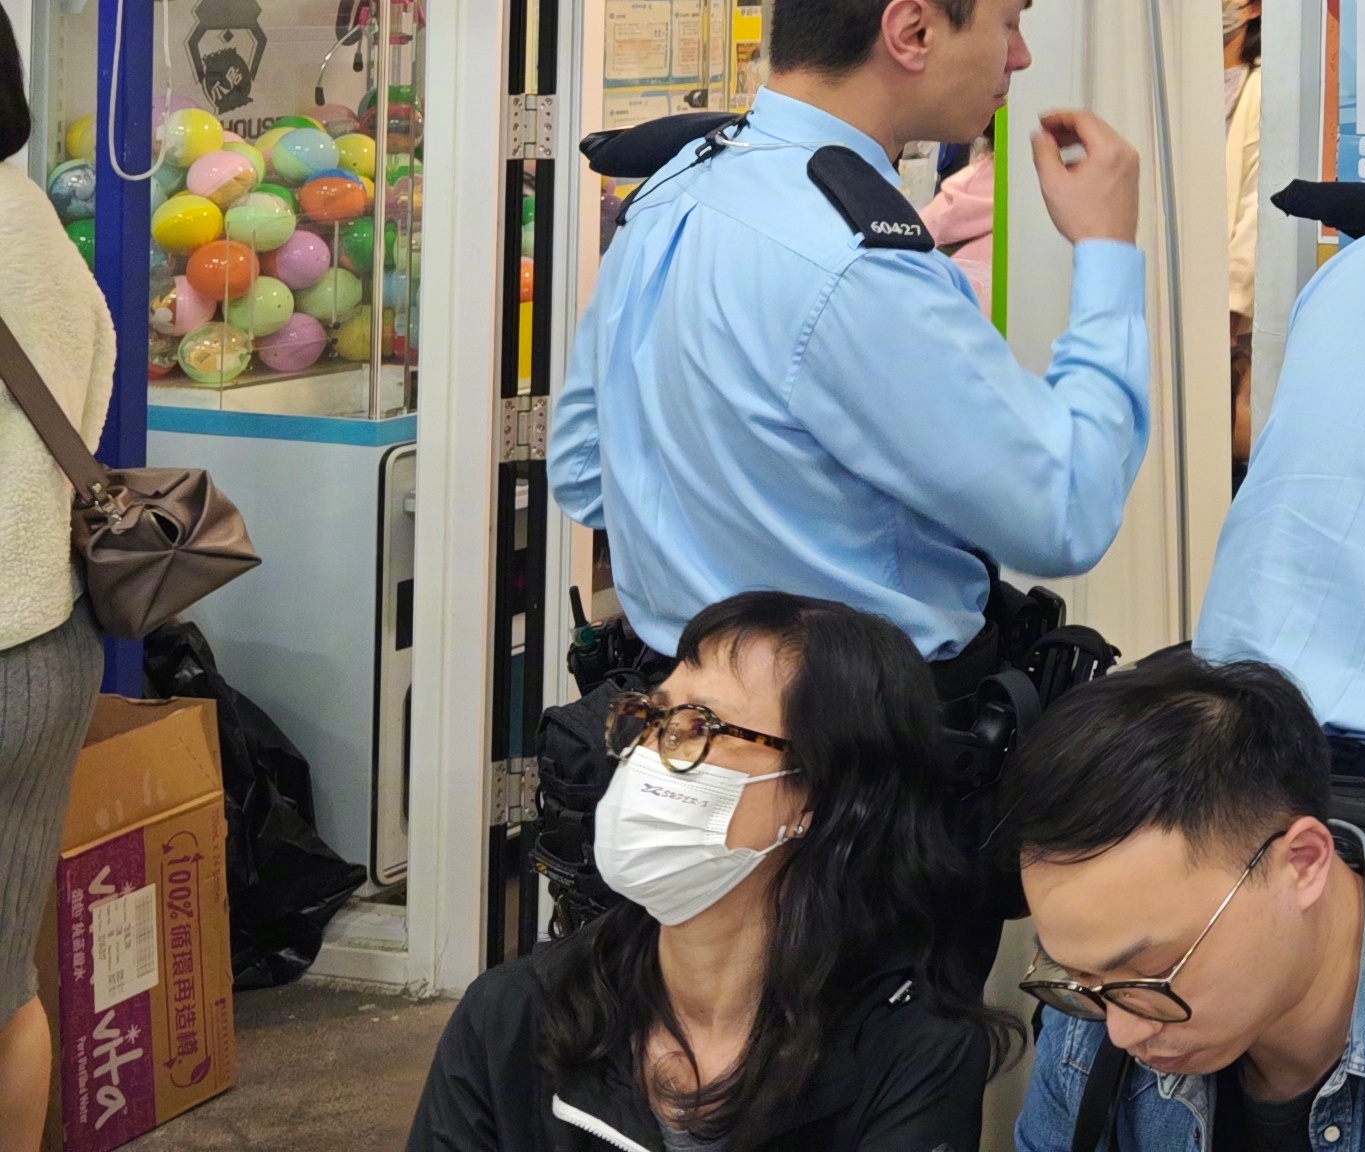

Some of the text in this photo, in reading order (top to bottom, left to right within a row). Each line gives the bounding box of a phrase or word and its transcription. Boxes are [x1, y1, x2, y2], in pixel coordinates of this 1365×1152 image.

[221, 116, 284, 140] HOUS
[870, 221, 922, 237] 60427
[92, 1009, 144, 1130] vita
